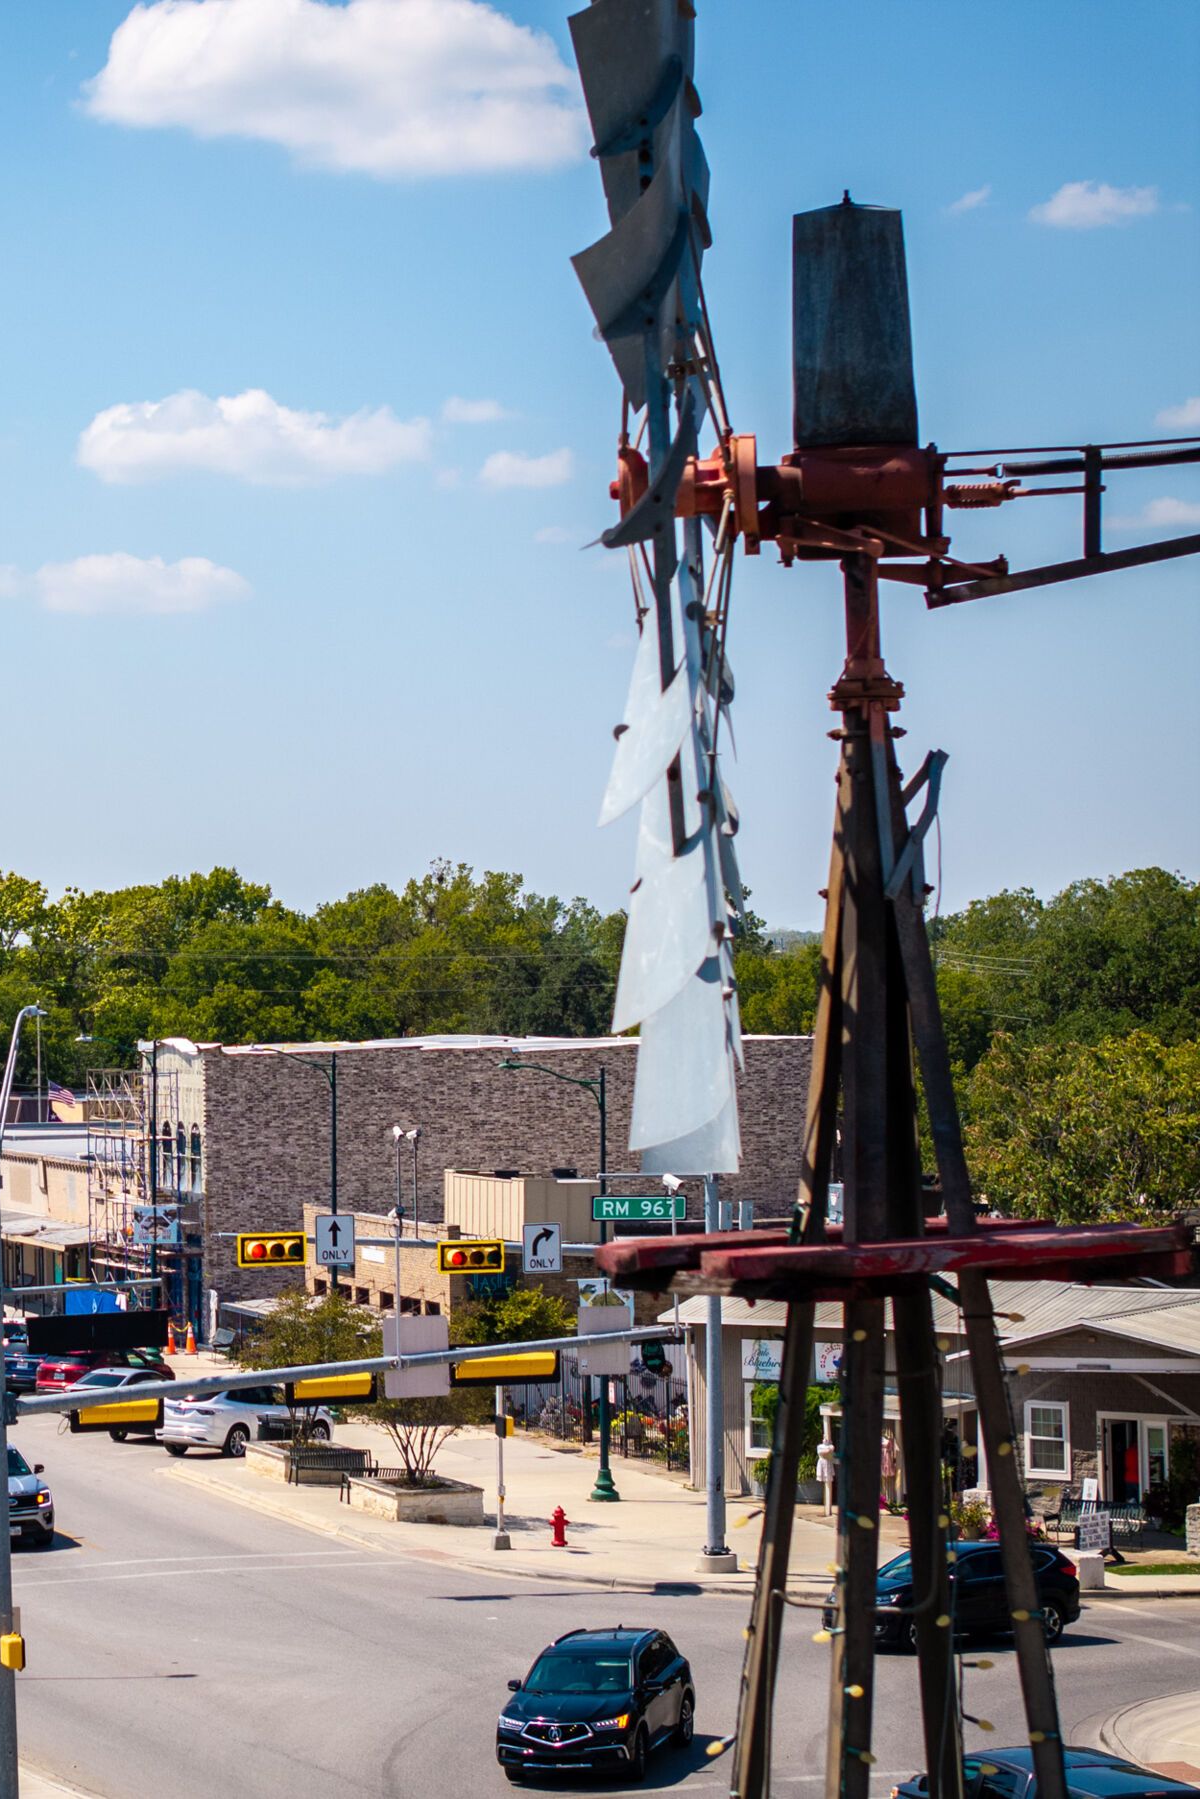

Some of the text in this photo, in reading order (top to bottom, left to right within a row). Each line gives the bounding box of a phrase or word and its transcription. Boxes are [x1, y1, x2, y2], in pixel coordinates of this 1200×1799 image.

[602, 1201, 675, 1216] RM 967
[322, 1250, 348, 1260] ONLY
[530, 1258, 554, 1269] ONLY
